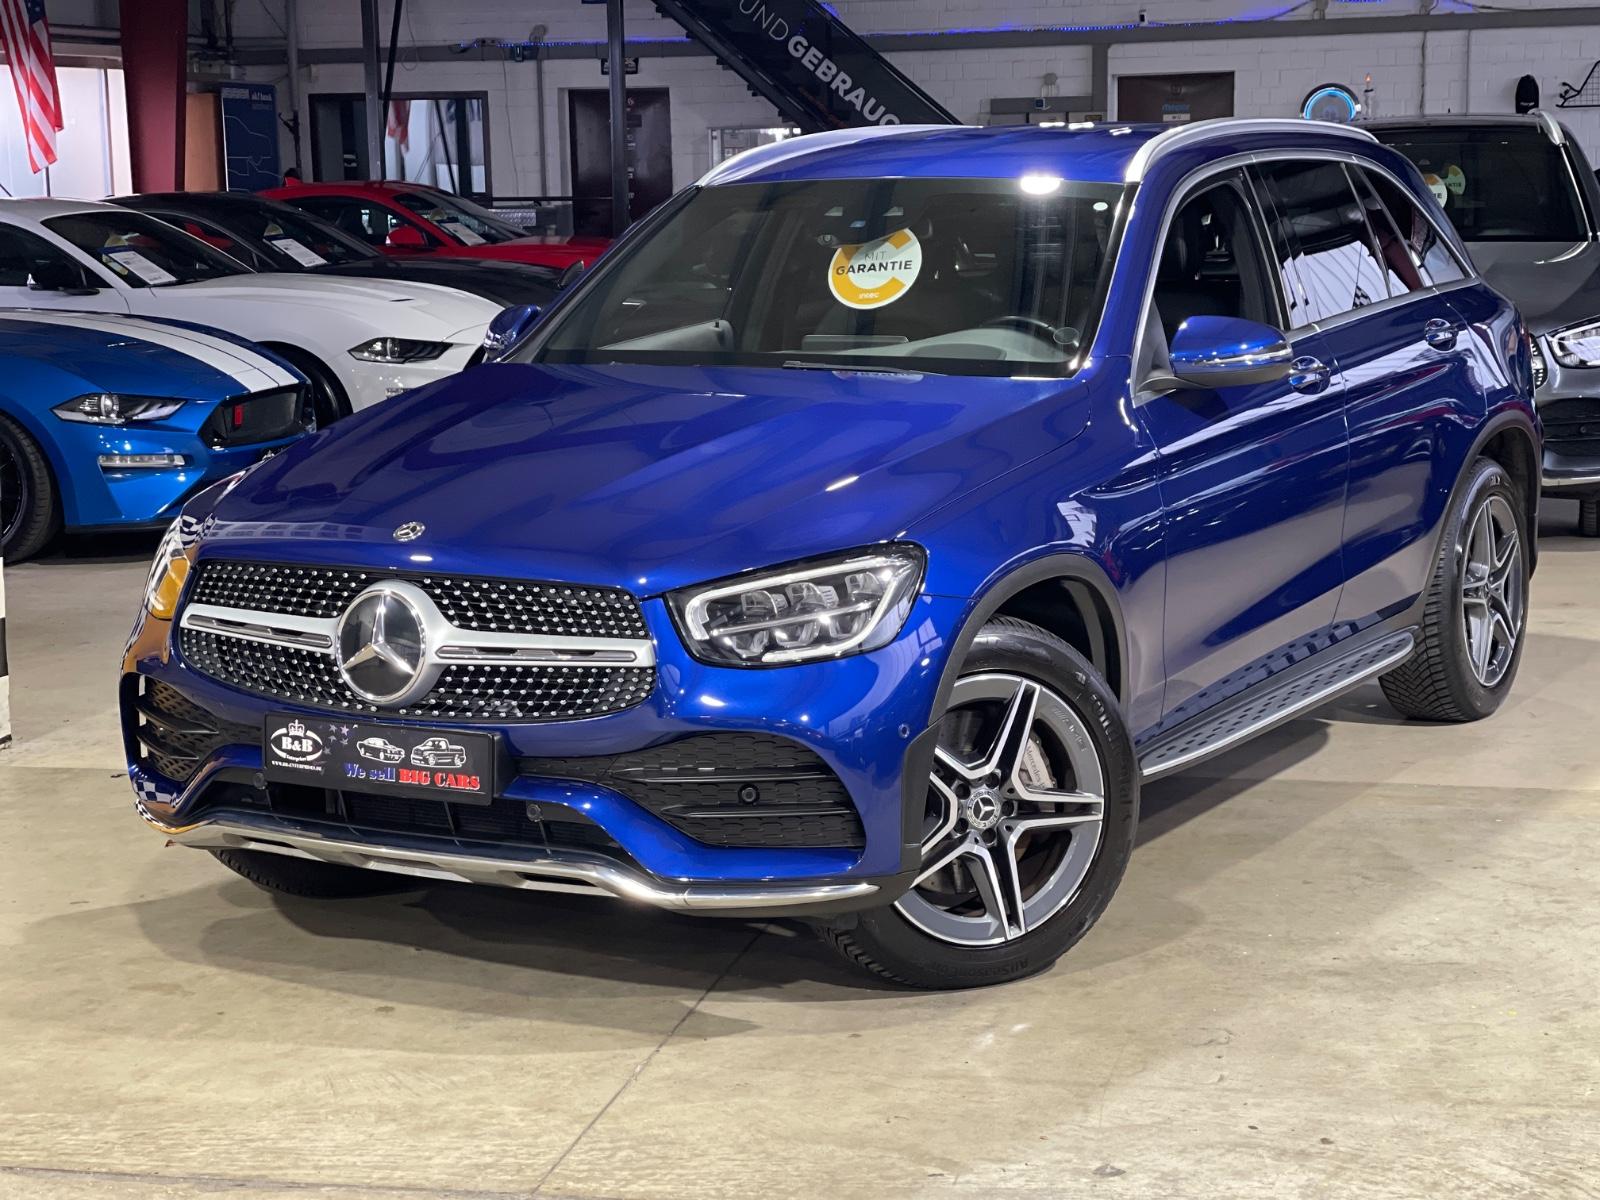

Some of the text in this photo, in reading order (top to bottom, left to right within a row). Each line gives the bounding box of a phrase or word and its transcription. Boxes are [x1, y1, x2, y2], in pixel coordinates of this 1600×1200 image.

[739, 0, 789, 41] UND
[864, 250, 887, 261] MIT
[836, 260, 913, 276] GARANTIE
[281, 736, 313, 753] B&B
[344, 761, 481, 791] We sell BIG CARS
